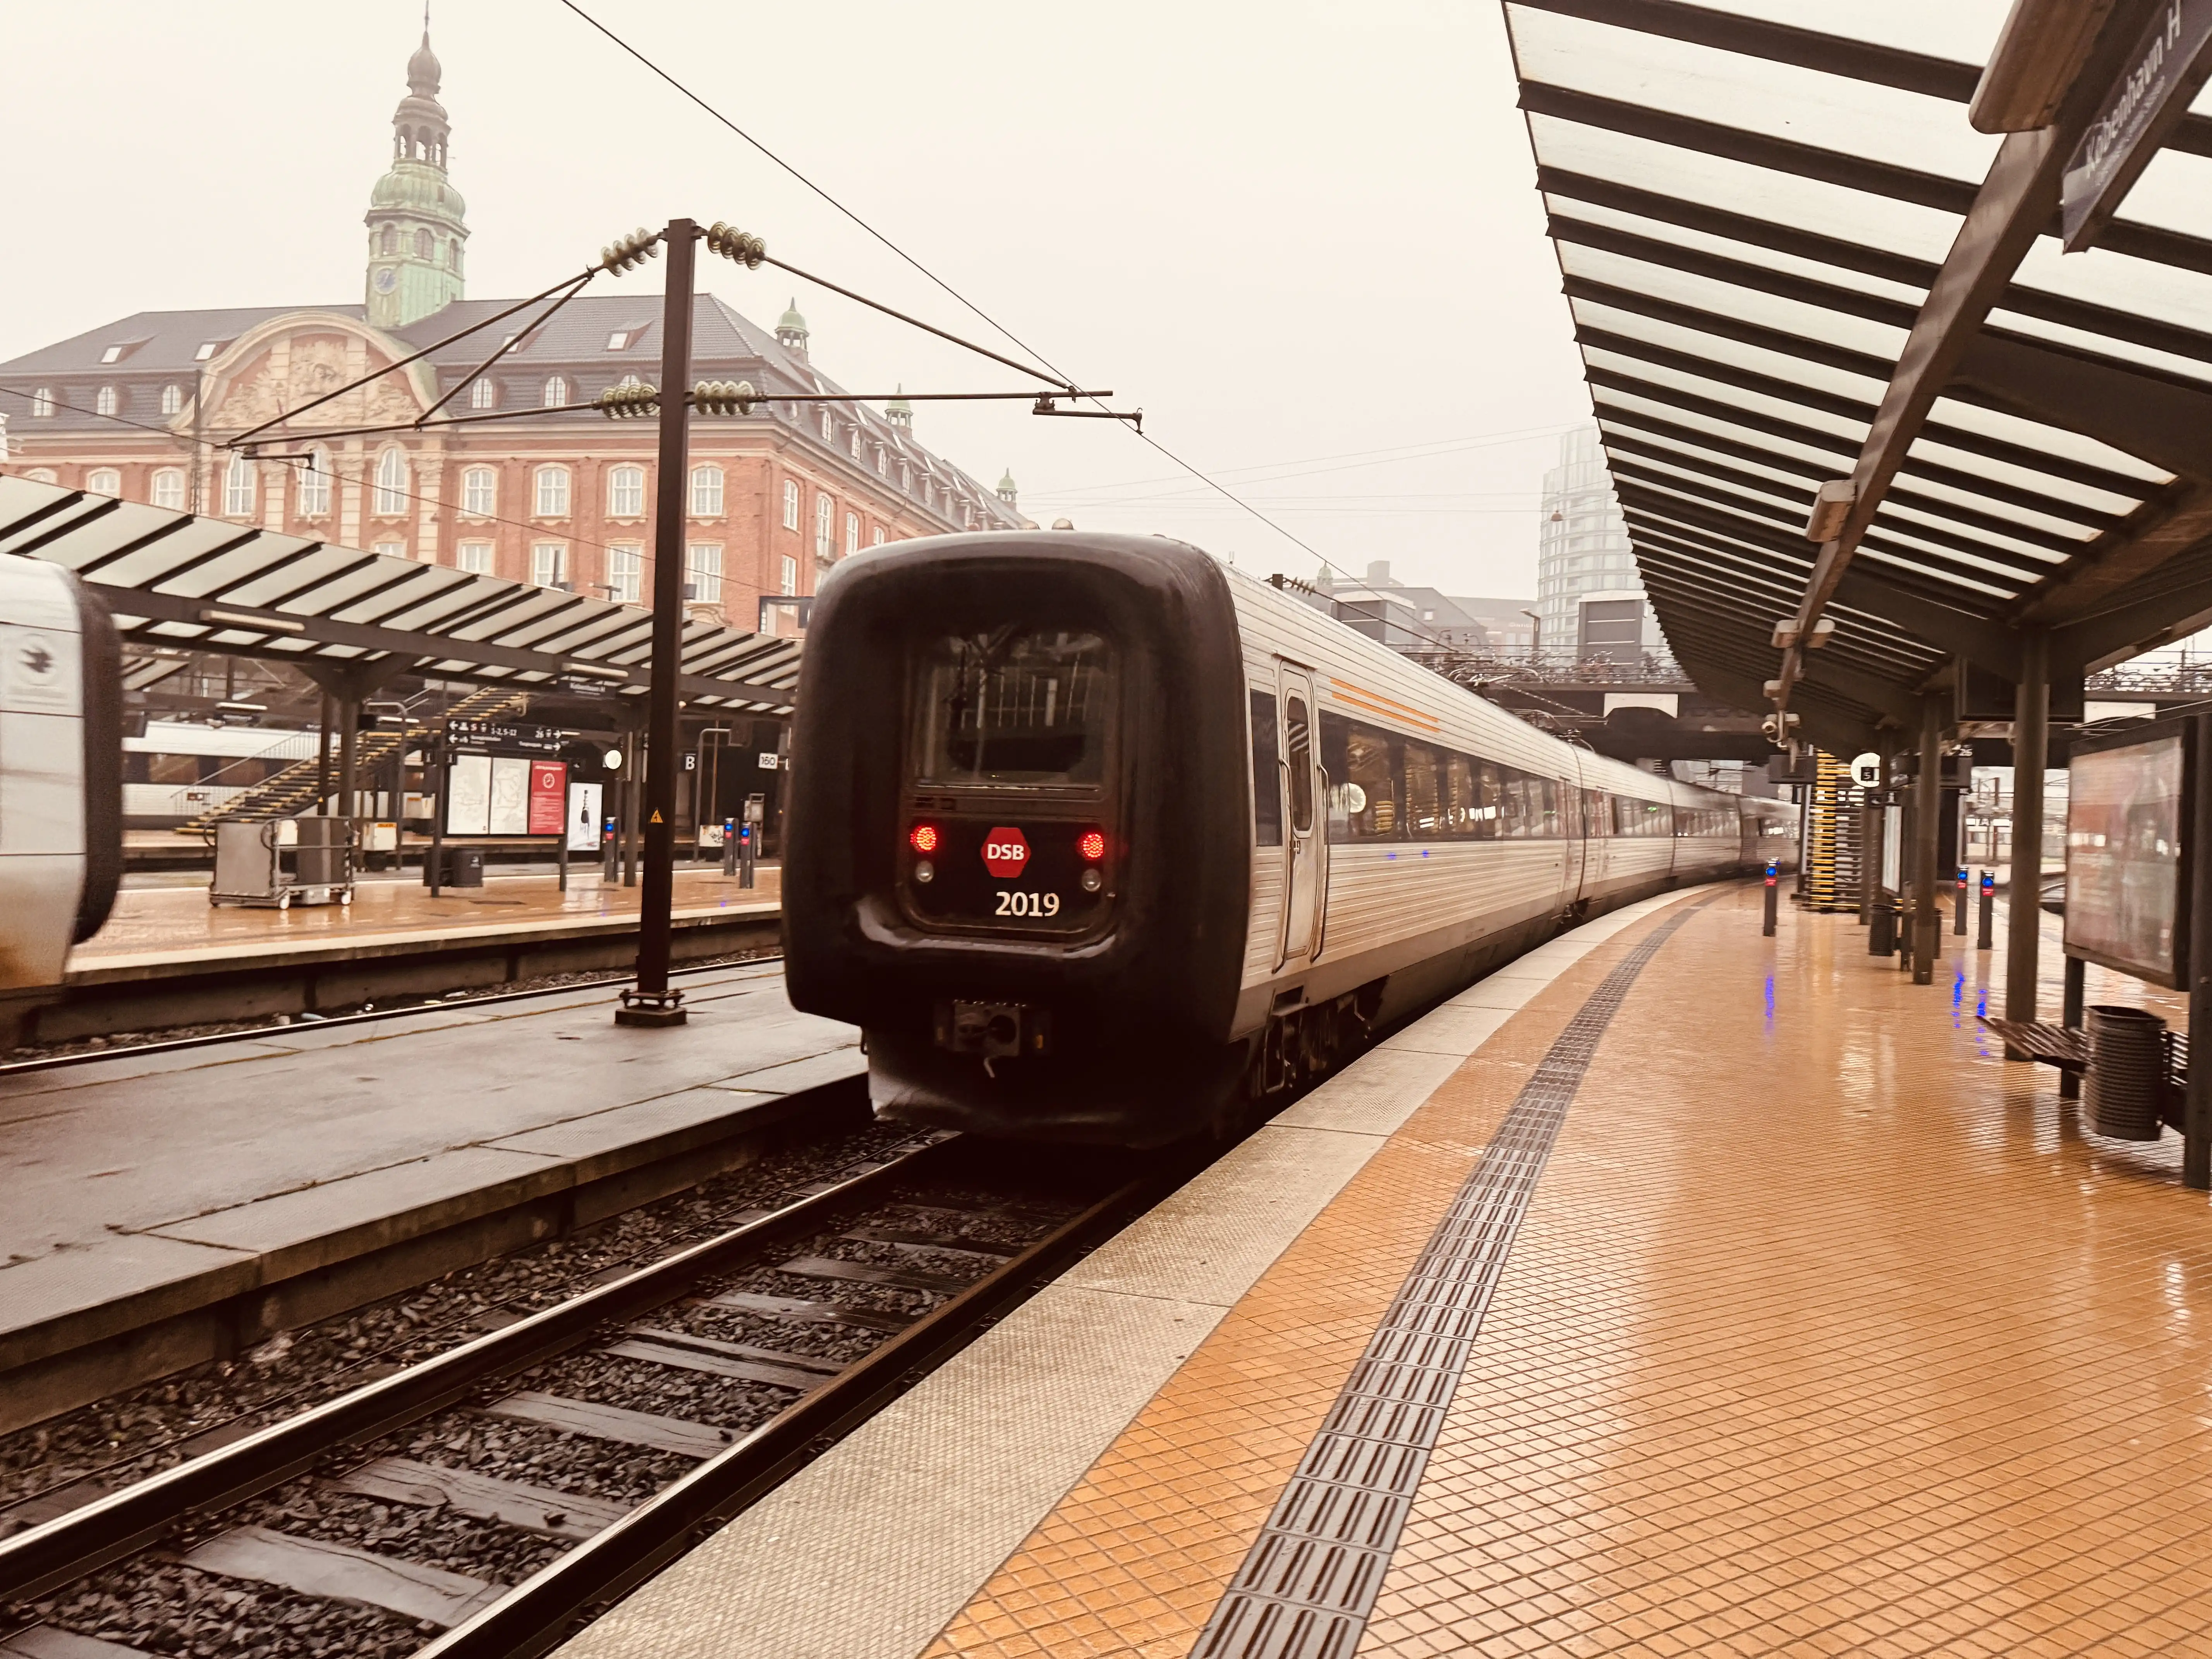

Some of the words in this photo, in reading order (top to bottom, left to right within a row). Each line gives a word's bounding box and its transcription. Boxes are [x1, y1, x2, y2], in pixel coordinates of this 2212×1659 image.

[685, 756, 695, 770] B
[761, 756, 776, 766] 160
[988, 843, 1025, 860] DSB
[995, 891, 1060, 917] 2019
